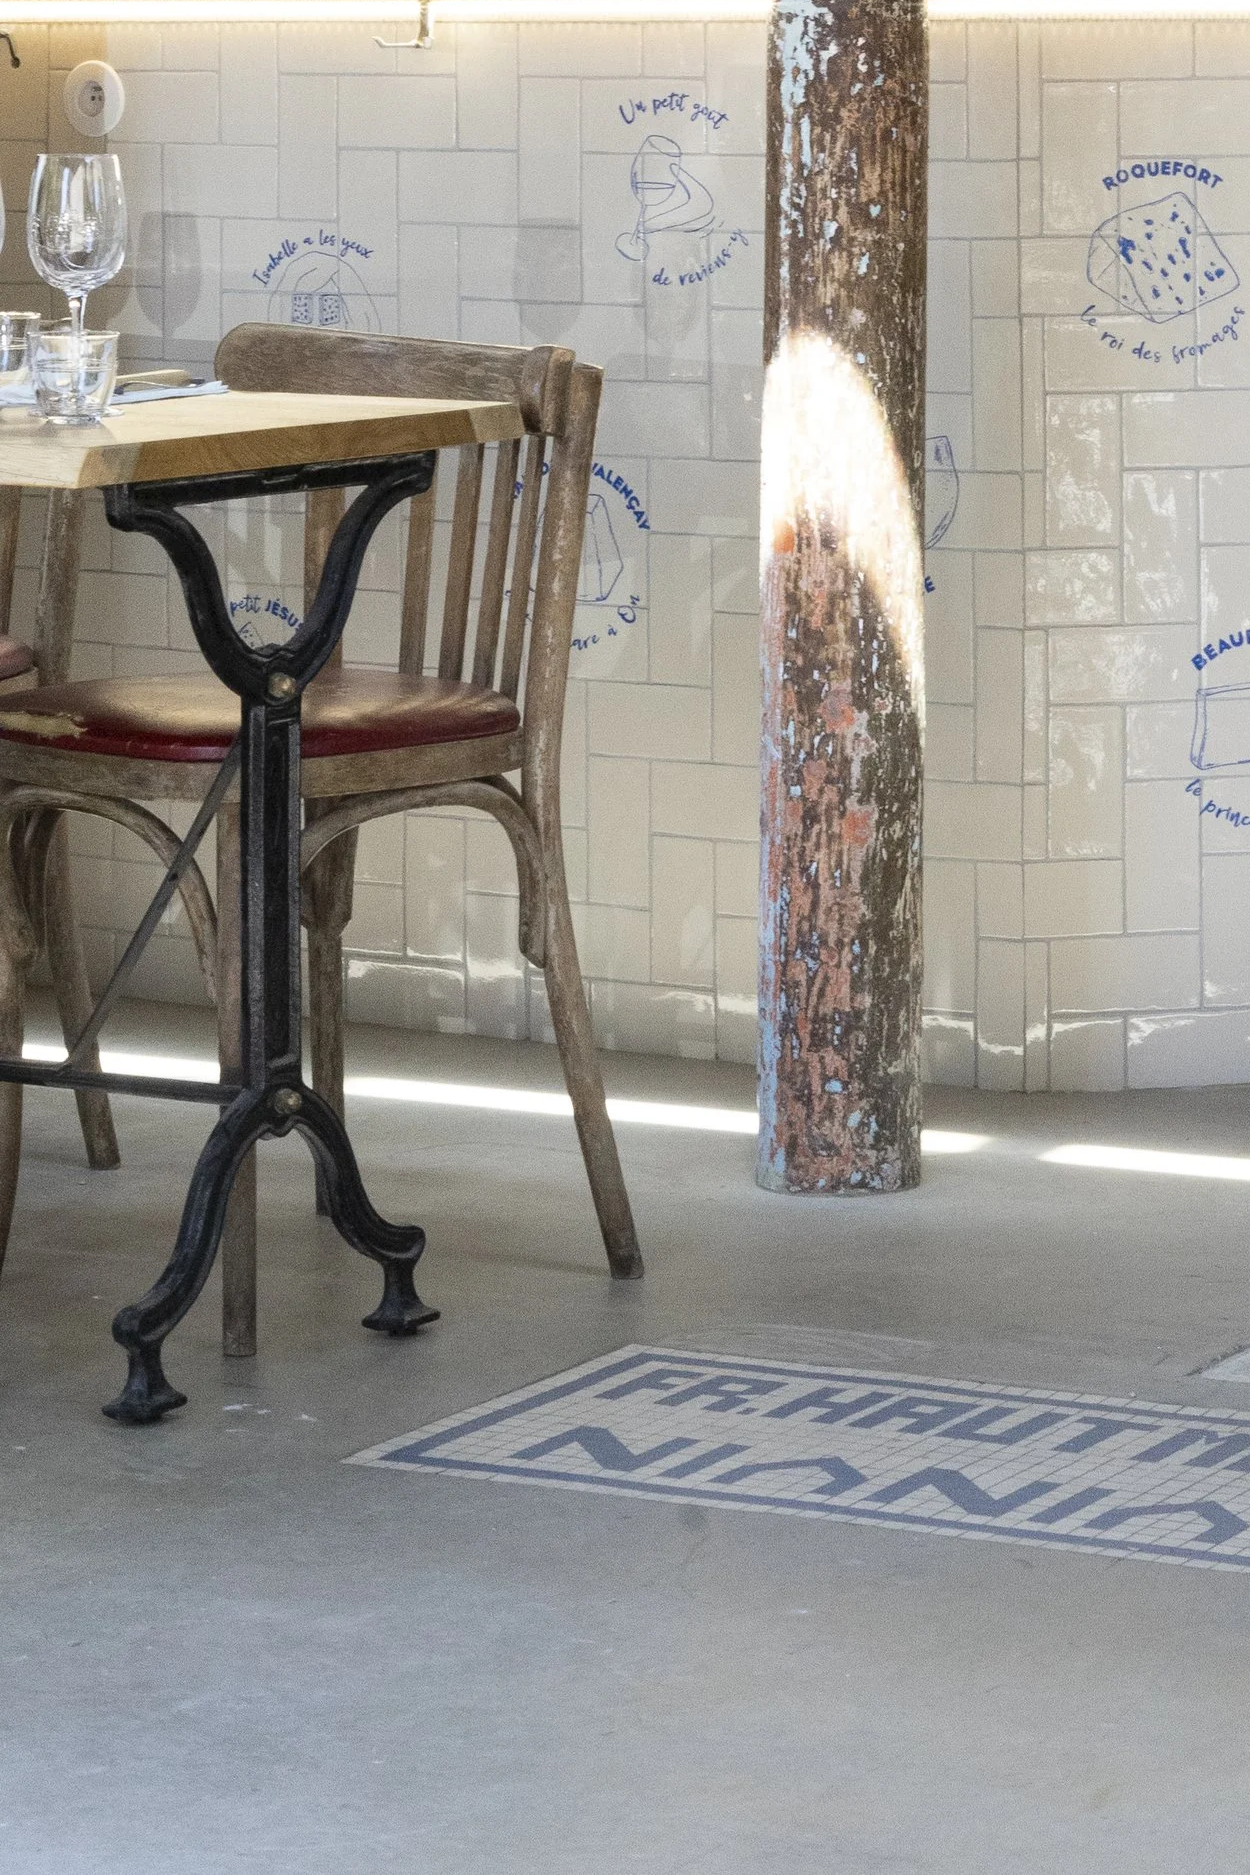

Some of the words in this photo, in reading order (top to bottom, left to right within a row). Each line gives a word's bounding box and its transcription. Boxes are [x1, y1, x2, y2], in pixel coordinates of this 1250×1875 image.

[619, 98, 647, 125] Un
[652, 92, 689, 116] petit
[1102, 161, 1224, 191] ROQUEFORT
[319, 228, 337, 246] les
[652, 267, 672, 286] de
[1100, 330, 1125, 351] roi
[1132, 340, 1162, 364] des
[1172, 306, 1246, 365] fromages
[230, 593, 261, 617] petit
[1185, 778, 1203, 797] le
[511, 1426, 1249, 1545] VINVIN
